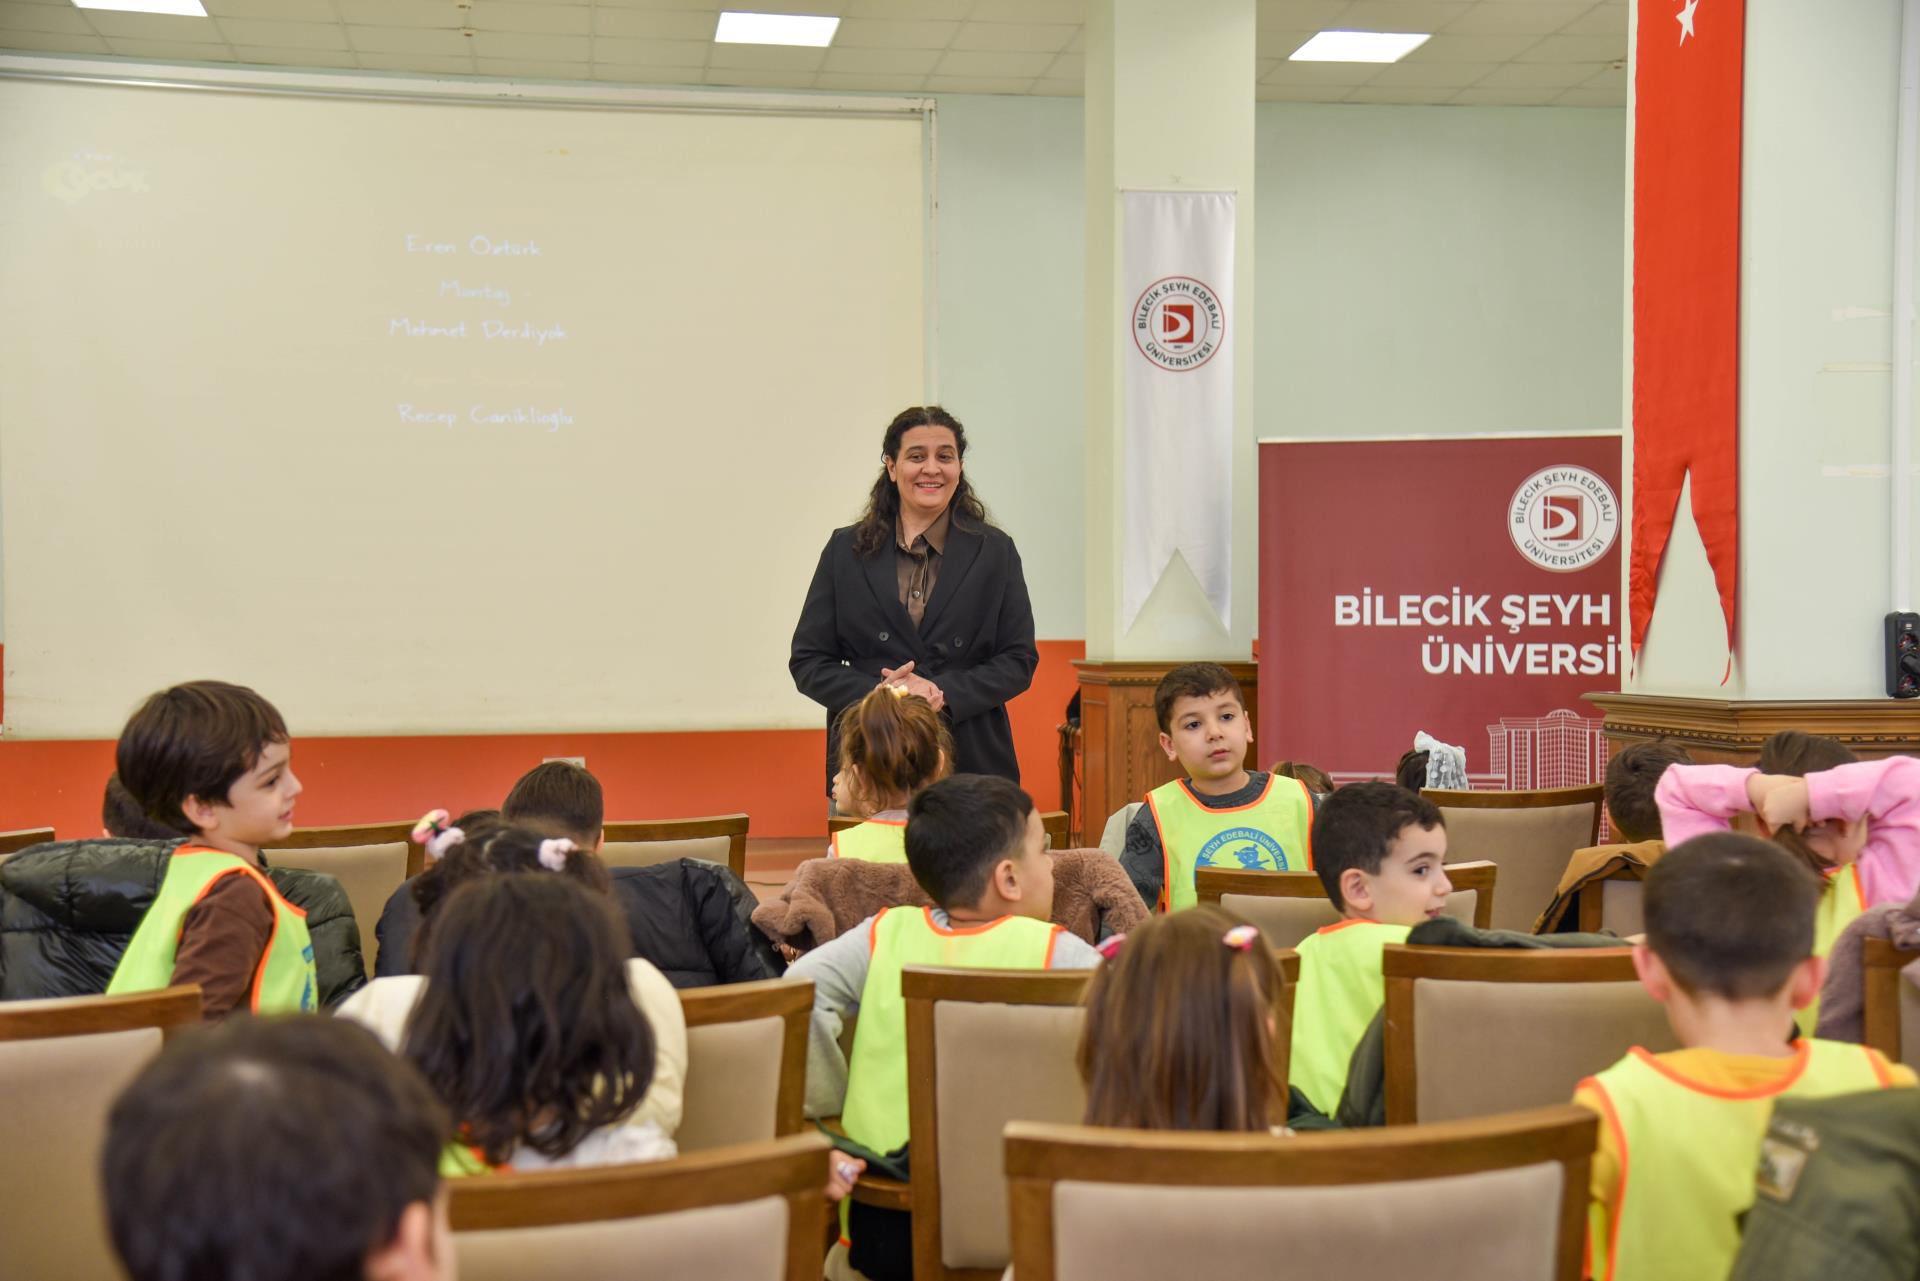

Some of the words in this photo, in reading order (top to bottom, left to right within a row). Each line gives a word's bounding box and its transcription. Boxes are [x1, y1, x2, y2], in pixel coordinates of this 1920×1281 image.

[403, 232, 456, 254] Eren
[1138, 289, 1162, 329] BİLECİK
[1162, 282, 1190, 294] ŞEYH
[1192, 286, 1221, 329] EDEBALİ
[388, 317, 466, 338] Mehmet
[1145, 342, 1213, 366] ÜNİVERSİTESİ
[398, 403, 457, 429] Recep
[1513, 479, 1543, 524] BİLECİK
[1544, 471, 1578, 486] ŞEYH
[1580, 475, 1615, 523] EDEBALİ
[1524, 538, 1605, 566] ÜNİVERSİTESİ
[1334, 586, 1491, 627] BİLECİK
[1501, 593, 1611, 634] ŞEYH
[1421, 635, 1622, 675] ÜNİVERSİ
[1222, 830, 1258, 843] EDEBALİ
